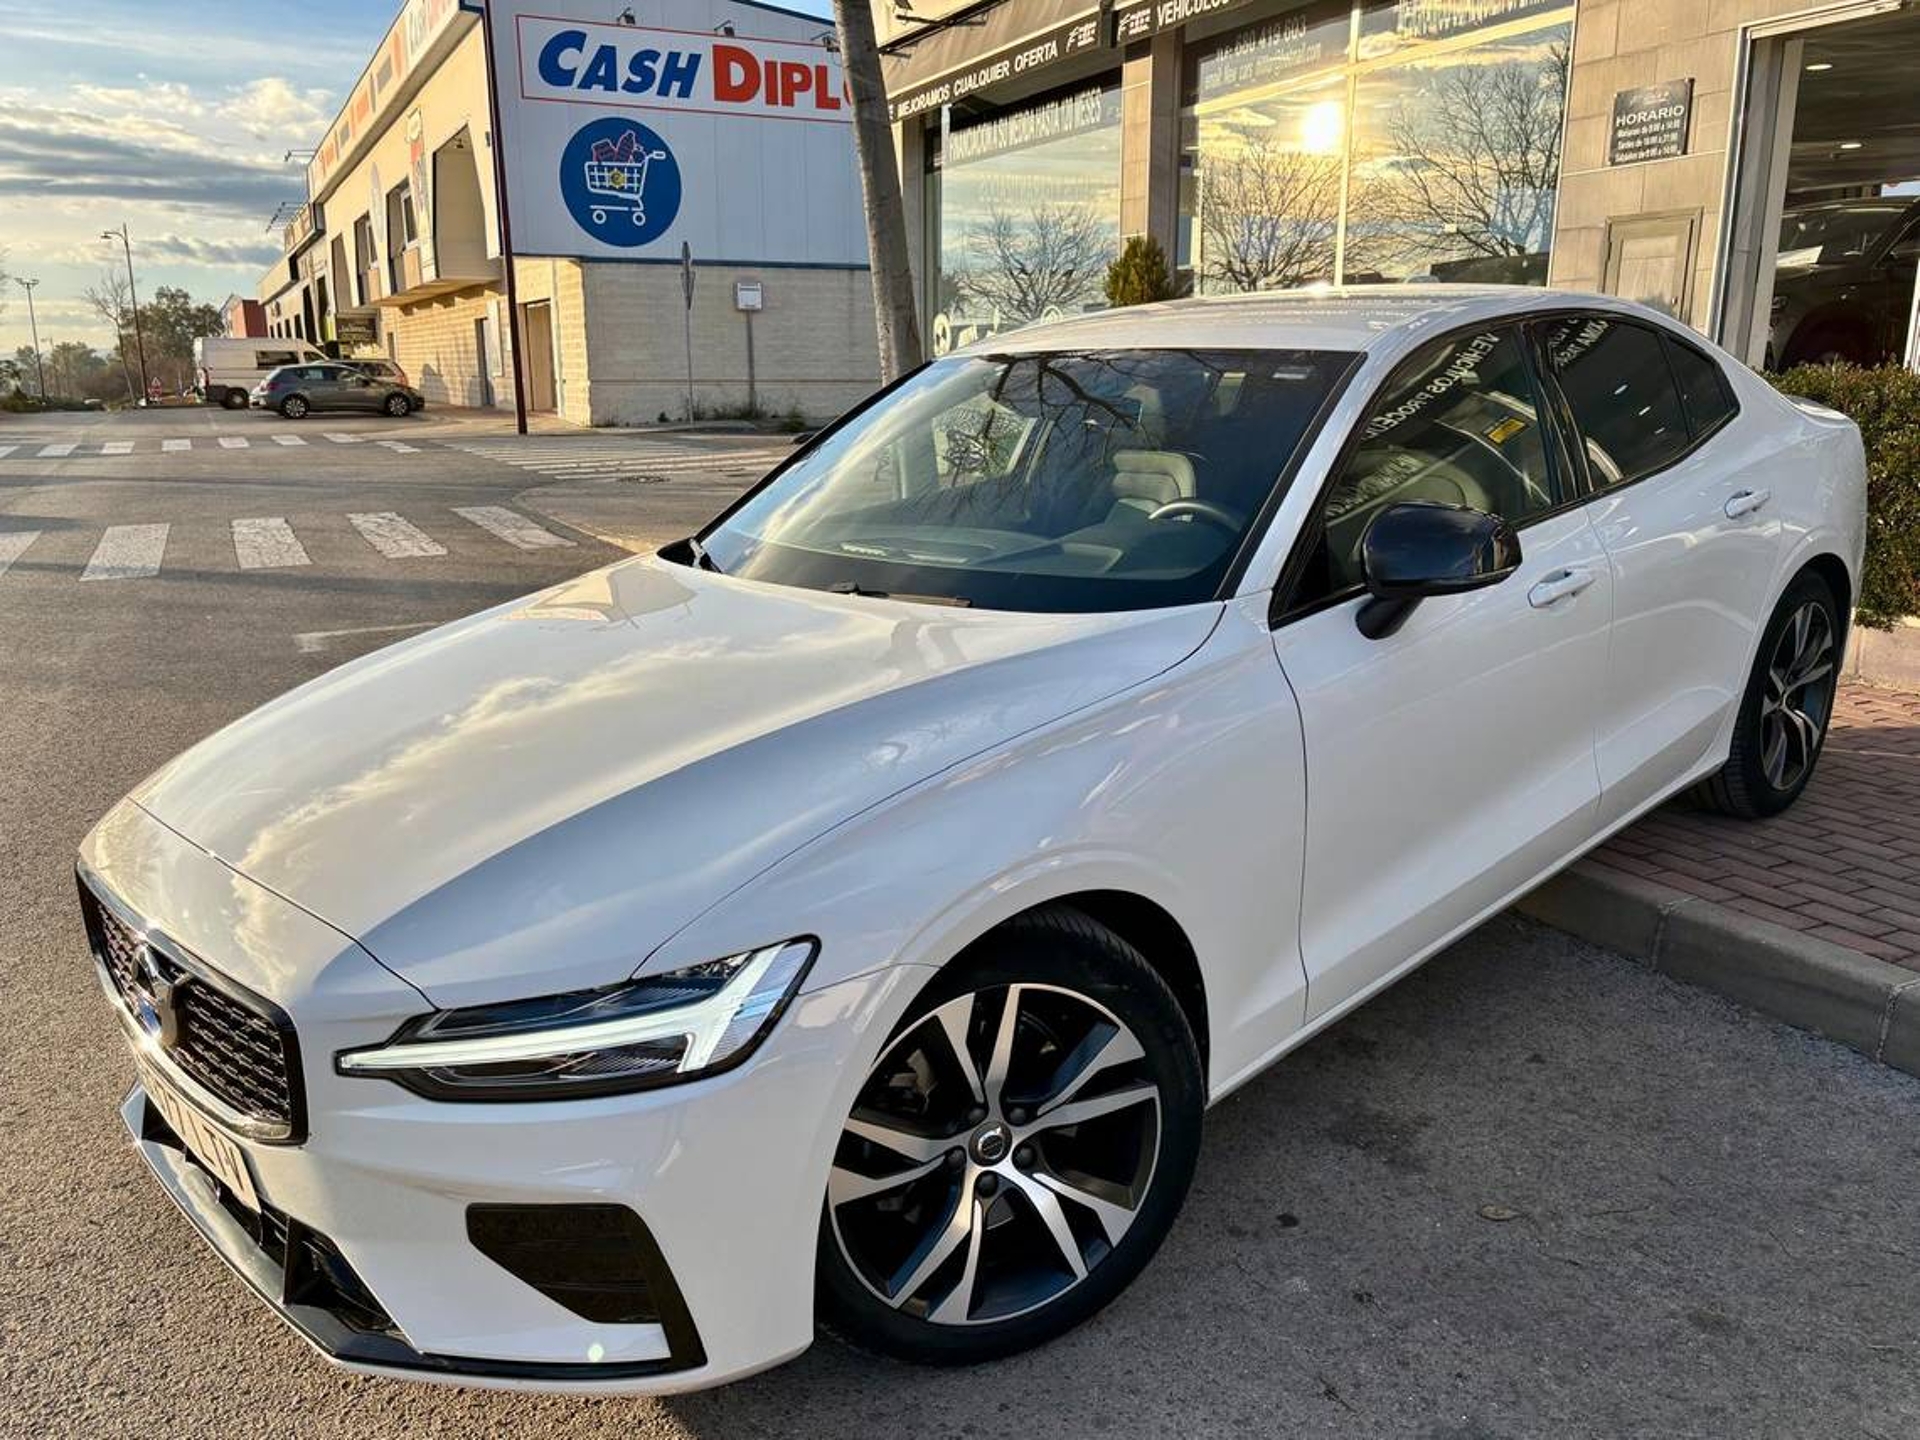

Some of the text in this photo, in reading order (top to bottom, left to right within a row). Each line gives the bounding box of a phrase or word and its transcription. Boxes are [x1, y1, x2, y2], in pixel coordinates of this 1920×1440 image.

[538, 30, 854, 110] CASH DIPL
[898, 84, 951, 119] MEJORAMOS
[953, 59, 1010, 96] CUALQUIER
[1014, 40, 1058, 72] OFERTA
[1616, 105, 1685, 127] HORARIO
